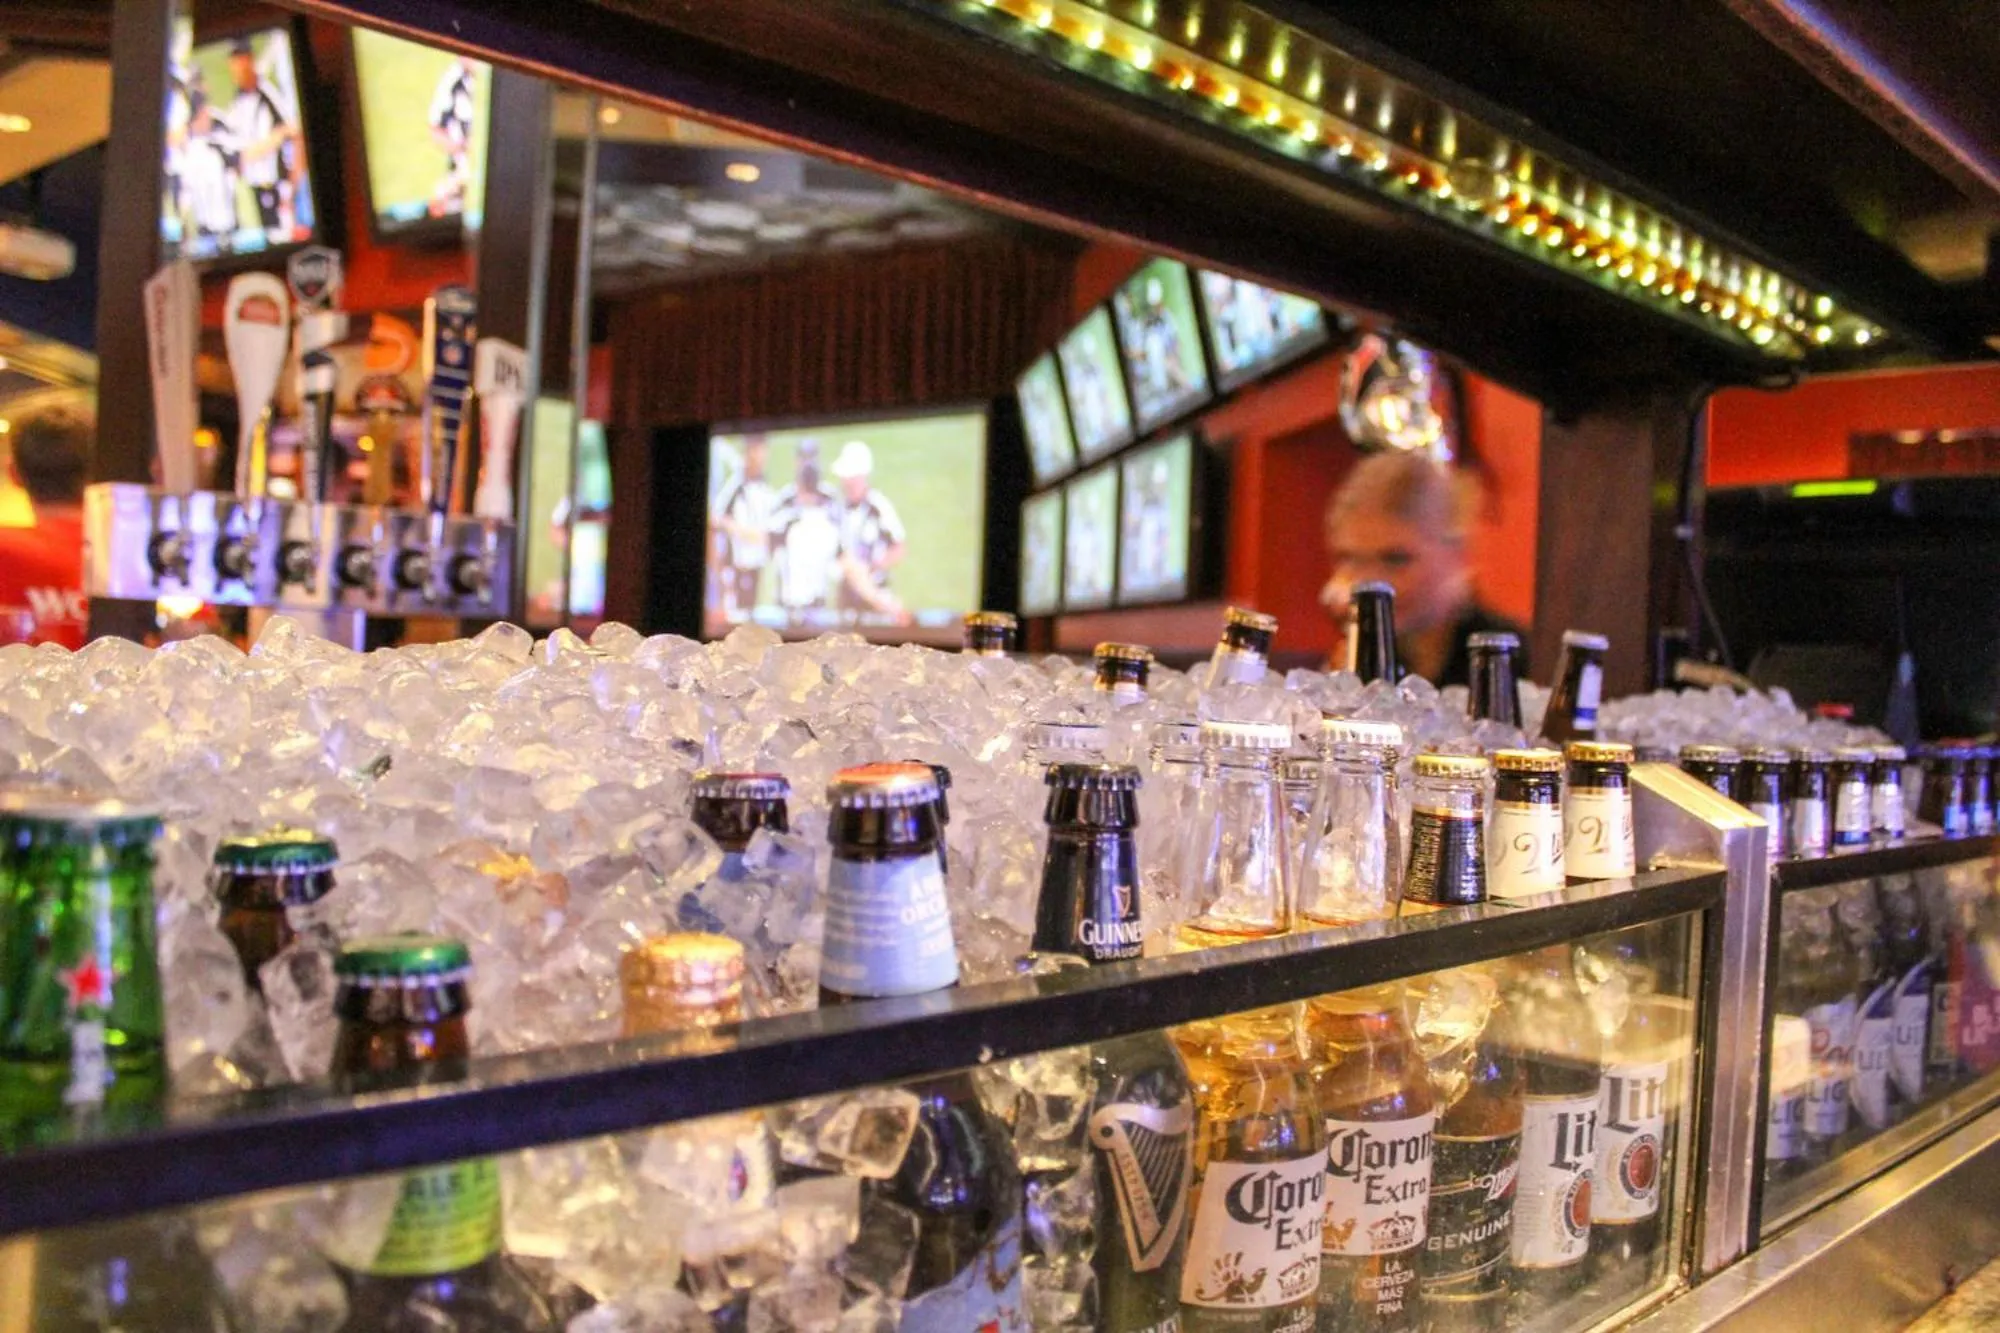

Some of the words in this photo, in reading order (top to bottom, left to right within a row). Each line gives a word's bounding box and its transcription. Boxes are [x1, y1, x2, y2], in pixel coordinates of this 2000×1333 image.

[1601, 1075, 1664, 1134] Lit
[1384, 1260, 1401, 1273] LA
[1376, 1300, 1403, 1315] FINA
